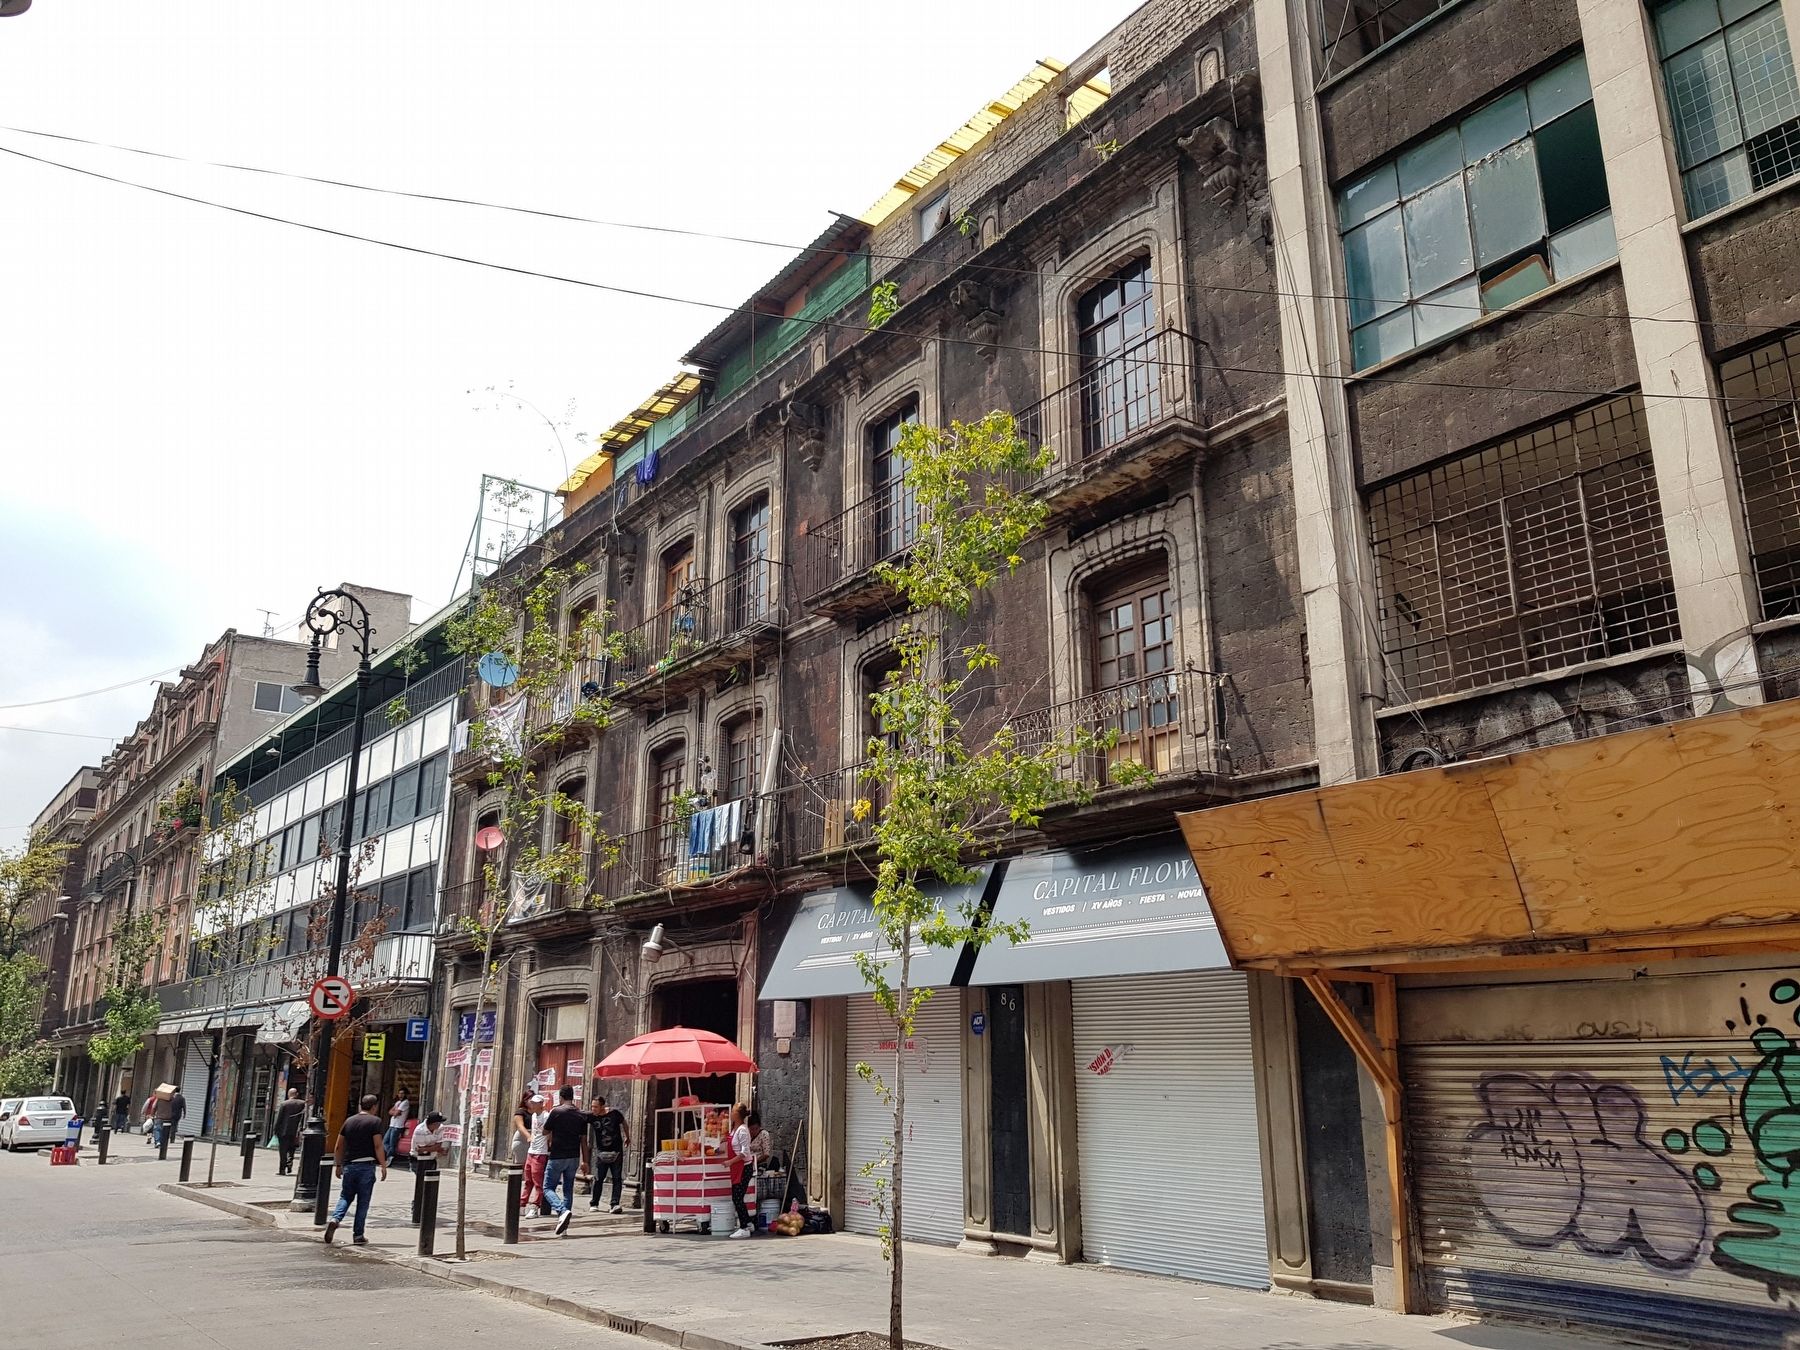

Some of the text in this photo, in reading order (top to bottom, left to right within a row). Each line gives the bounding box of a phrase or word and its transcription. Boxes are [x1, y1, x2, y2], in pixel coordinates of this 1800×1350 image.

[1033, 859, 1199, 901] CAPITAL FLOW
[1043, 904, 1075, 916] VESTIDOS
[1091, 900, 1103, 911] XV
[1102, 898, 1123, 909] AÑOS
[1139, 893, 1166, 905] FIESTA
[817, 907, 876, 930] CAPITAL
[820, 936, 842, 944] VESTIDOS
[323, 986, 341, 1008] E
[1000, 992, 1016, 1011] 86
[410, 1021, 424, 1038] E
[973, 1016, 983, 1025] ADT
[368, 1035, 382, 1053] E
